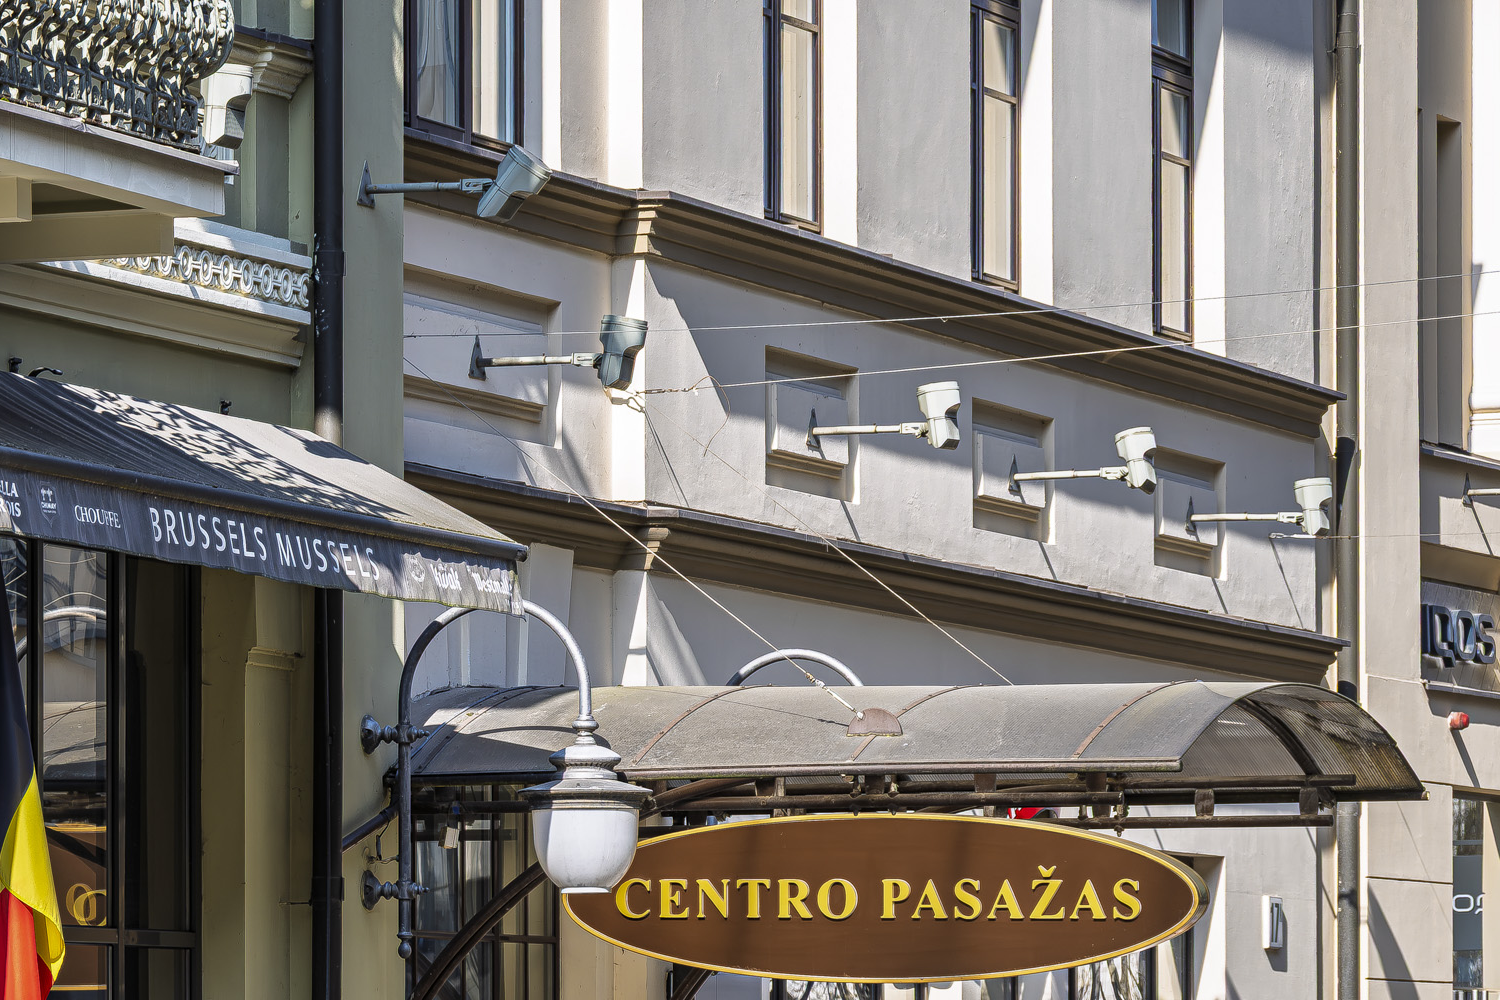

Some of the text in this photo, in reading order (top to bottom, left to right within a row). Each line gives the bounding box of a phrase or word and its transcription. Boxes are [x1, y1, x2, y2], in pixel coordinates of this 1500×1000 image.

[74, 505, 121, 529] CHOUFFE
[150, 507, 380, 581] BRUSSELS MUSSELS
[615, 865, 1143, 921] CENTRO PASAŽAS
